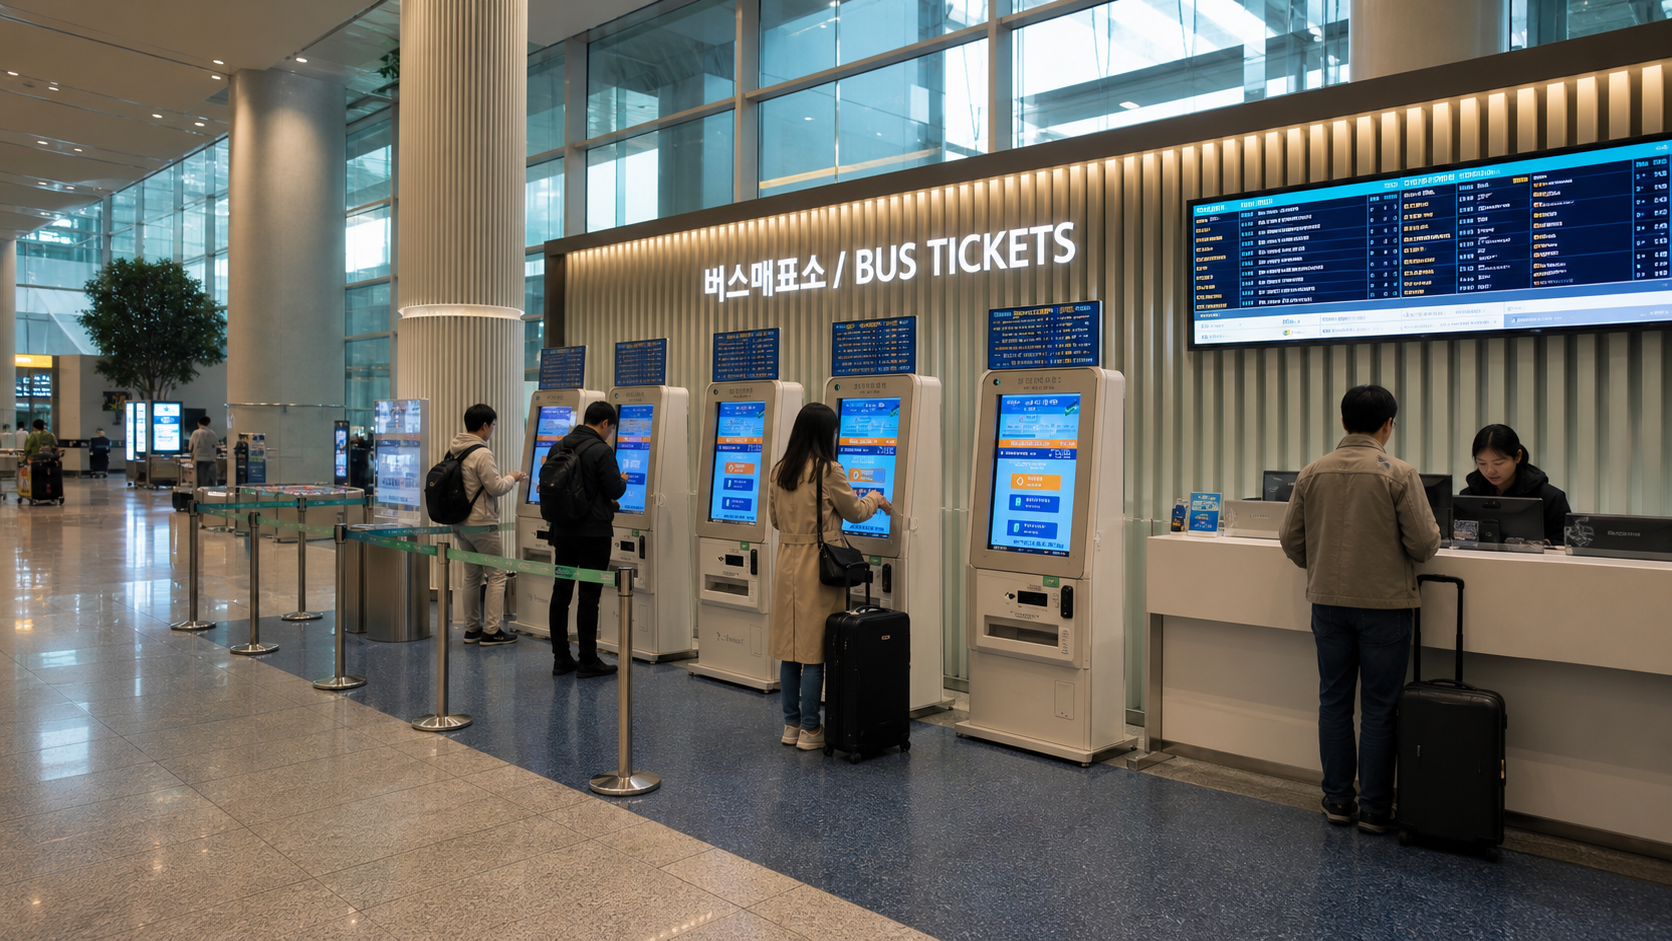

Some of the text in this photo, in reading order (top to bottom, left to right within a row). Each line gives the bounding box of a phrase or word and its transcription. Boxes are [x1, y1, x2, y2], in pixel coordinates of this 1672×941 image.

[704, 222, 1076, 302] 버스매표소 / BUS TICKETS
